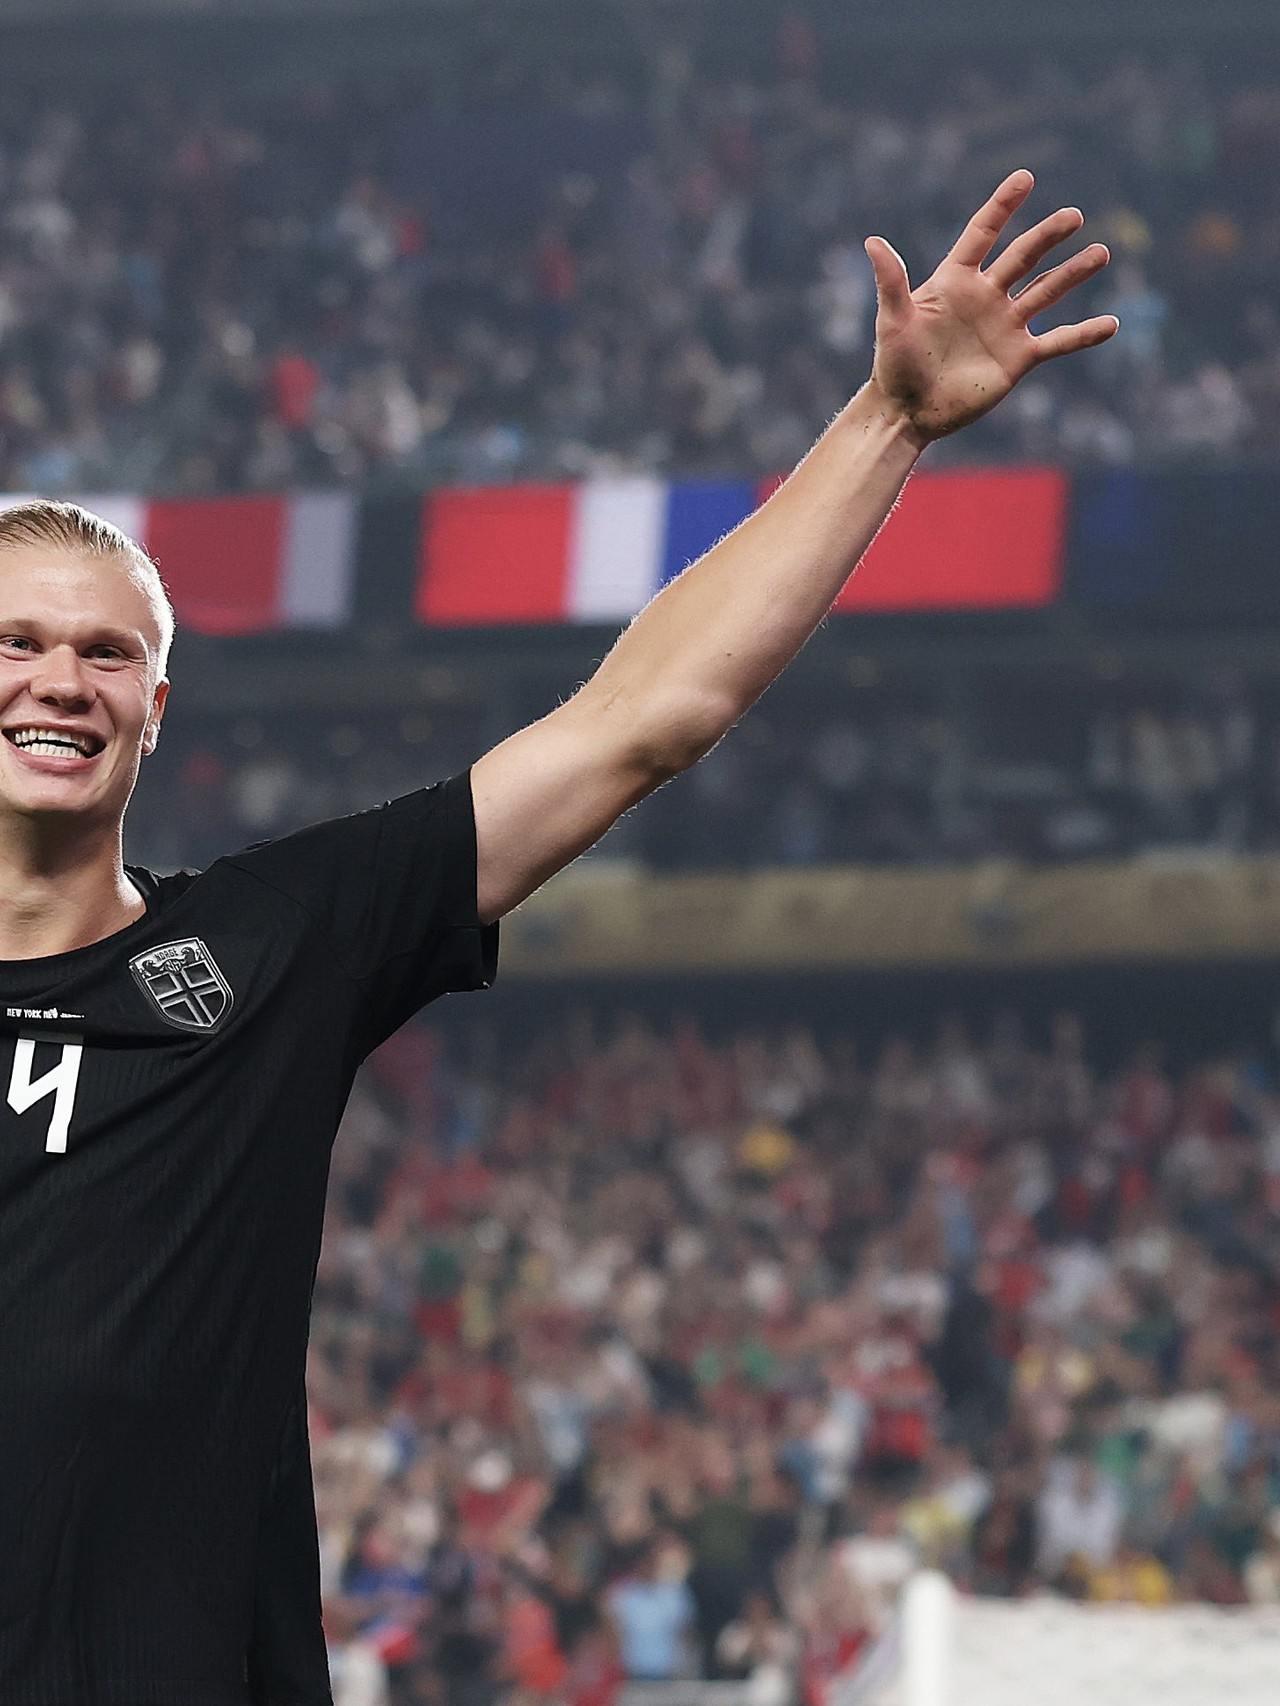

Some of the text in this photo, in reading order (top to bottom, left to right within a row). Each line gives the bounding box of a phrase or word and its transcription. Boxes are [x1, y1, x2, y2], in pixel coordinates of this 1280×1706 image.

[153, 947, 179, 960] NORGE
[6, 1007, 22, 1018] NEW
[23, 1008, 42, 1019] YORK
